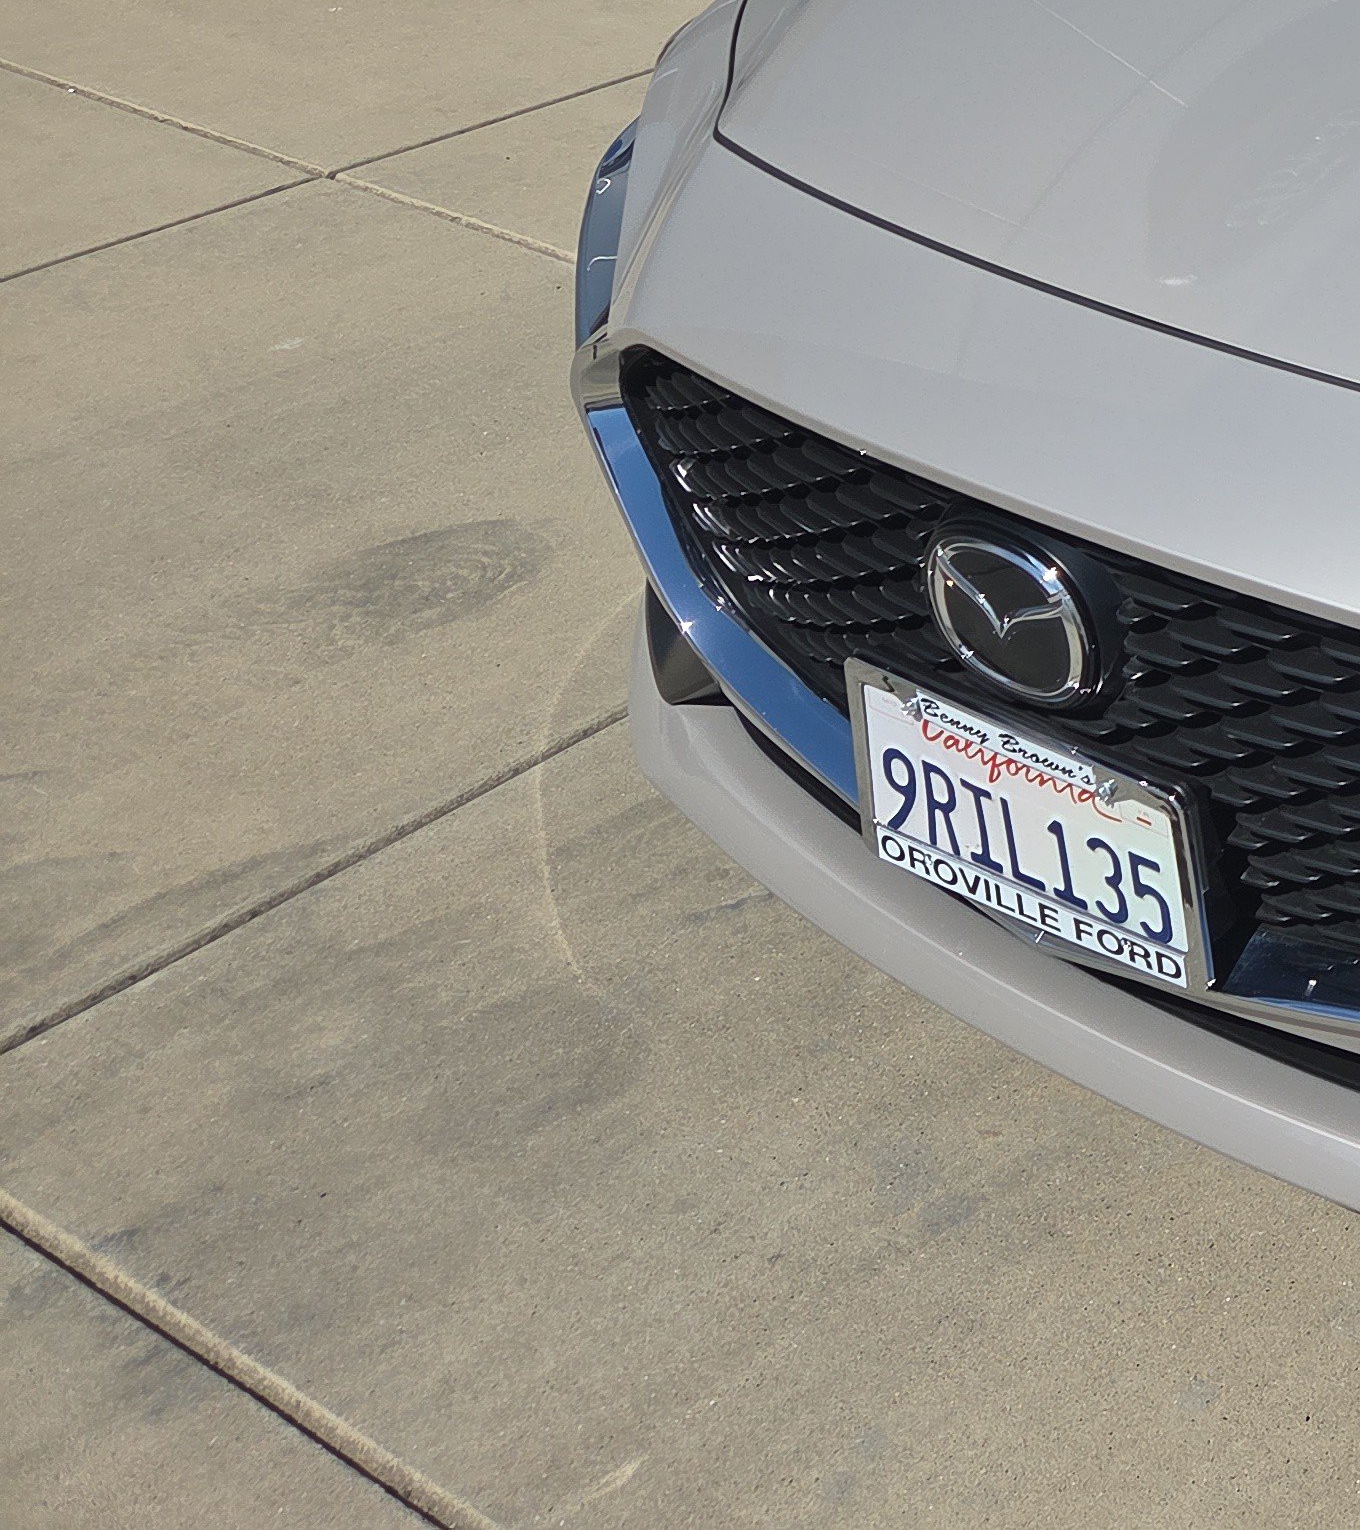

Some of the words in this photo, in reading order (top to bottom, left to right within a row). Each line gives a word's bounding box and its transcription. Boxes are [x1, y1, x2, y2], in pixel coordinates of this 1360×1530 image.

[921, 698, 990, 745] Benny
[998, 732, 1095, 787] Brown's
[881, 834, 1062, 933] OROVILLE
[1073, 918, 1183, 981] FORD
[882, 747, 1174, 945] 9RIL135
